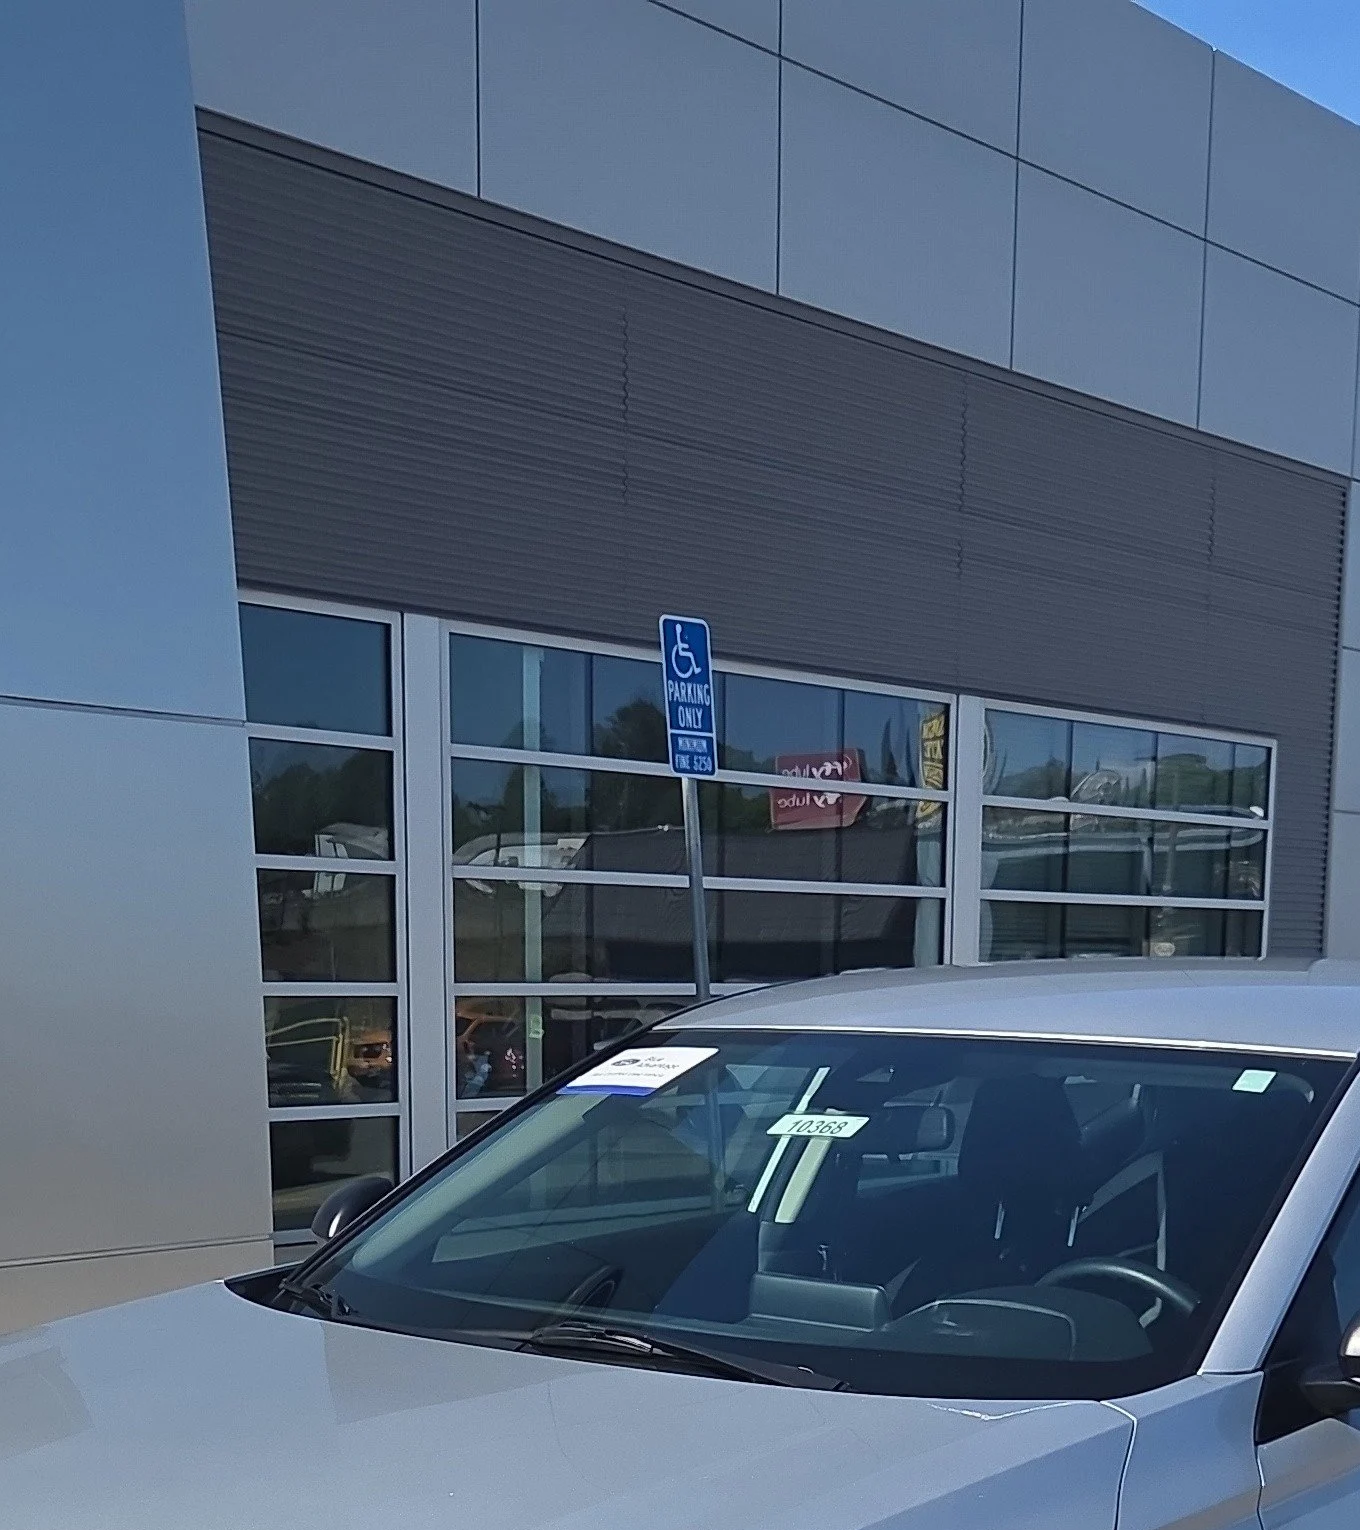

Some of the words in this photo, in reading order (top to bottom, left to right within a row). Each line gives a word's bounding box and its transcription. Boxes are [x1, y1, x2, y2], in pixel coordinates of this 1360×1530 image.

[667, 679, 711, 707] PARKING
[677, 706, 704, 729] ONLY
[787, 1119, 849, 1135] 10368
